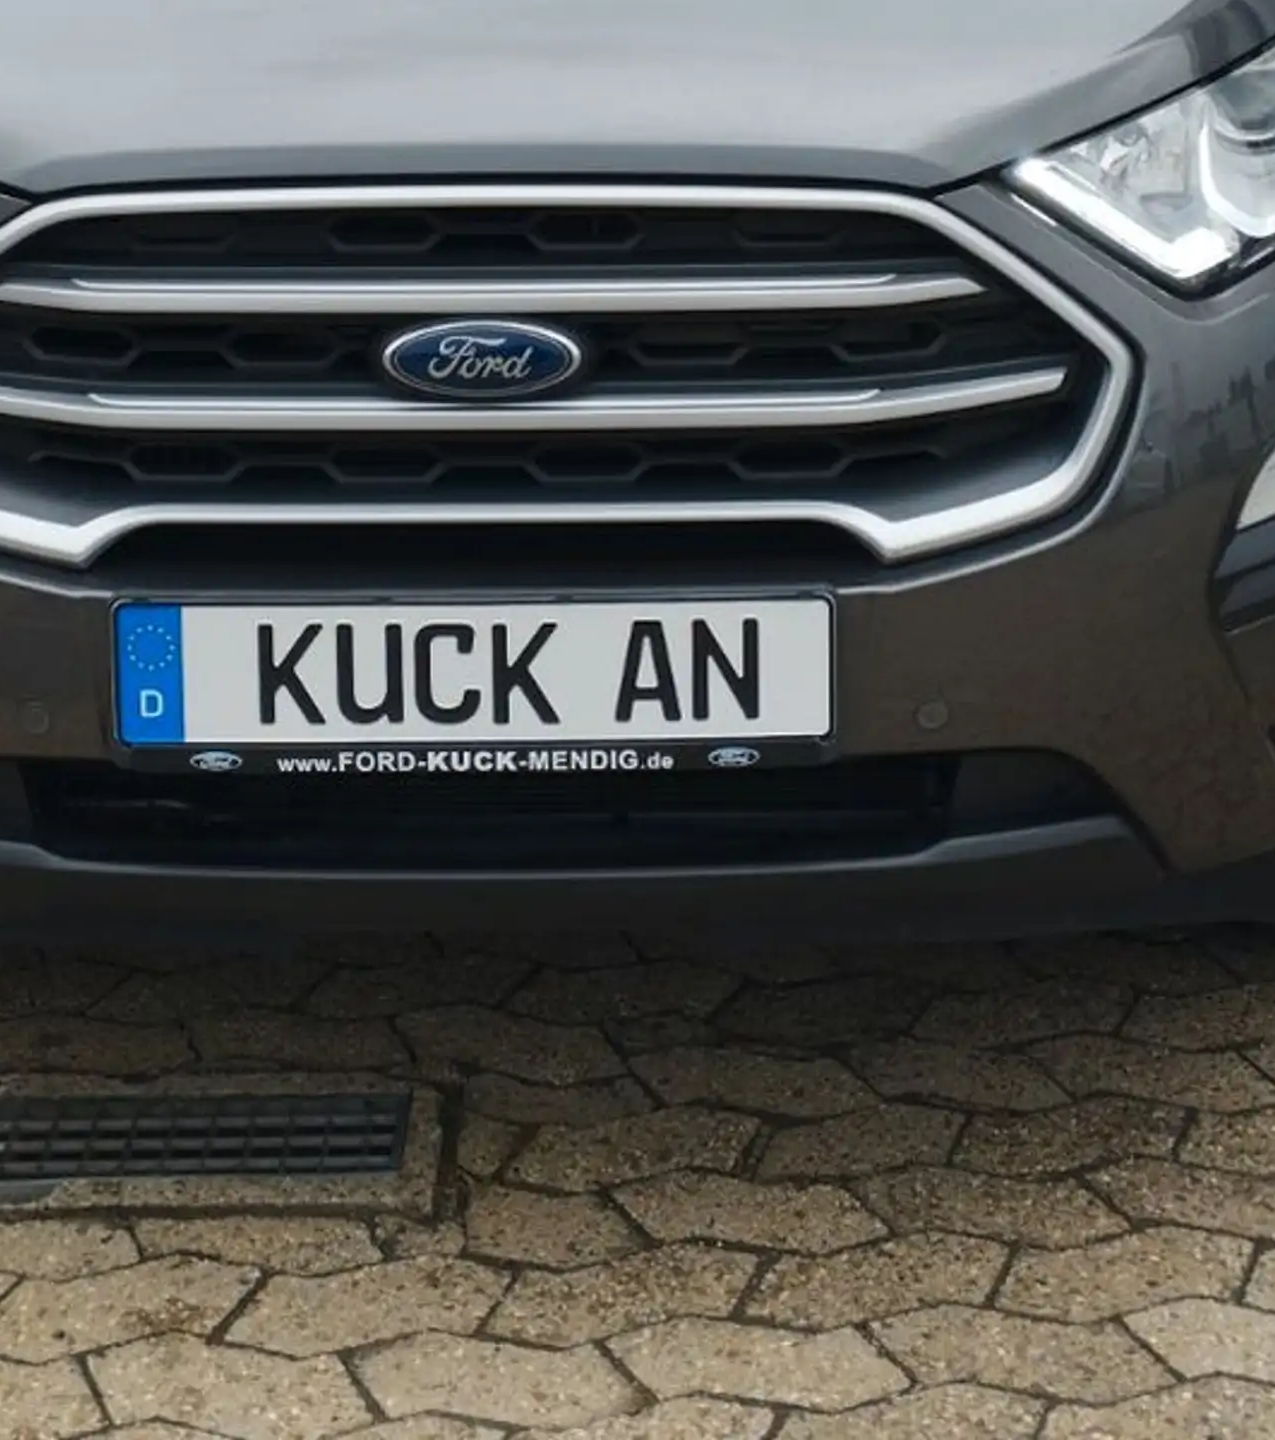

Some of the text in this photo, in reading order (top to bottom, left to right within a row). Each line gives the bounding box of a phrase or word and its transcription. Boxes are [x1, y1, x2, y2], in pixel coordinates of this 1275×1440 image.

[428, 336, 533, 379] Ford
[256, 617, 760, 726] KUCK AN
[140, 690, 163, 718] D
[278, 749, 674, 773] www.FORD-KUCK-MENDIG.de
